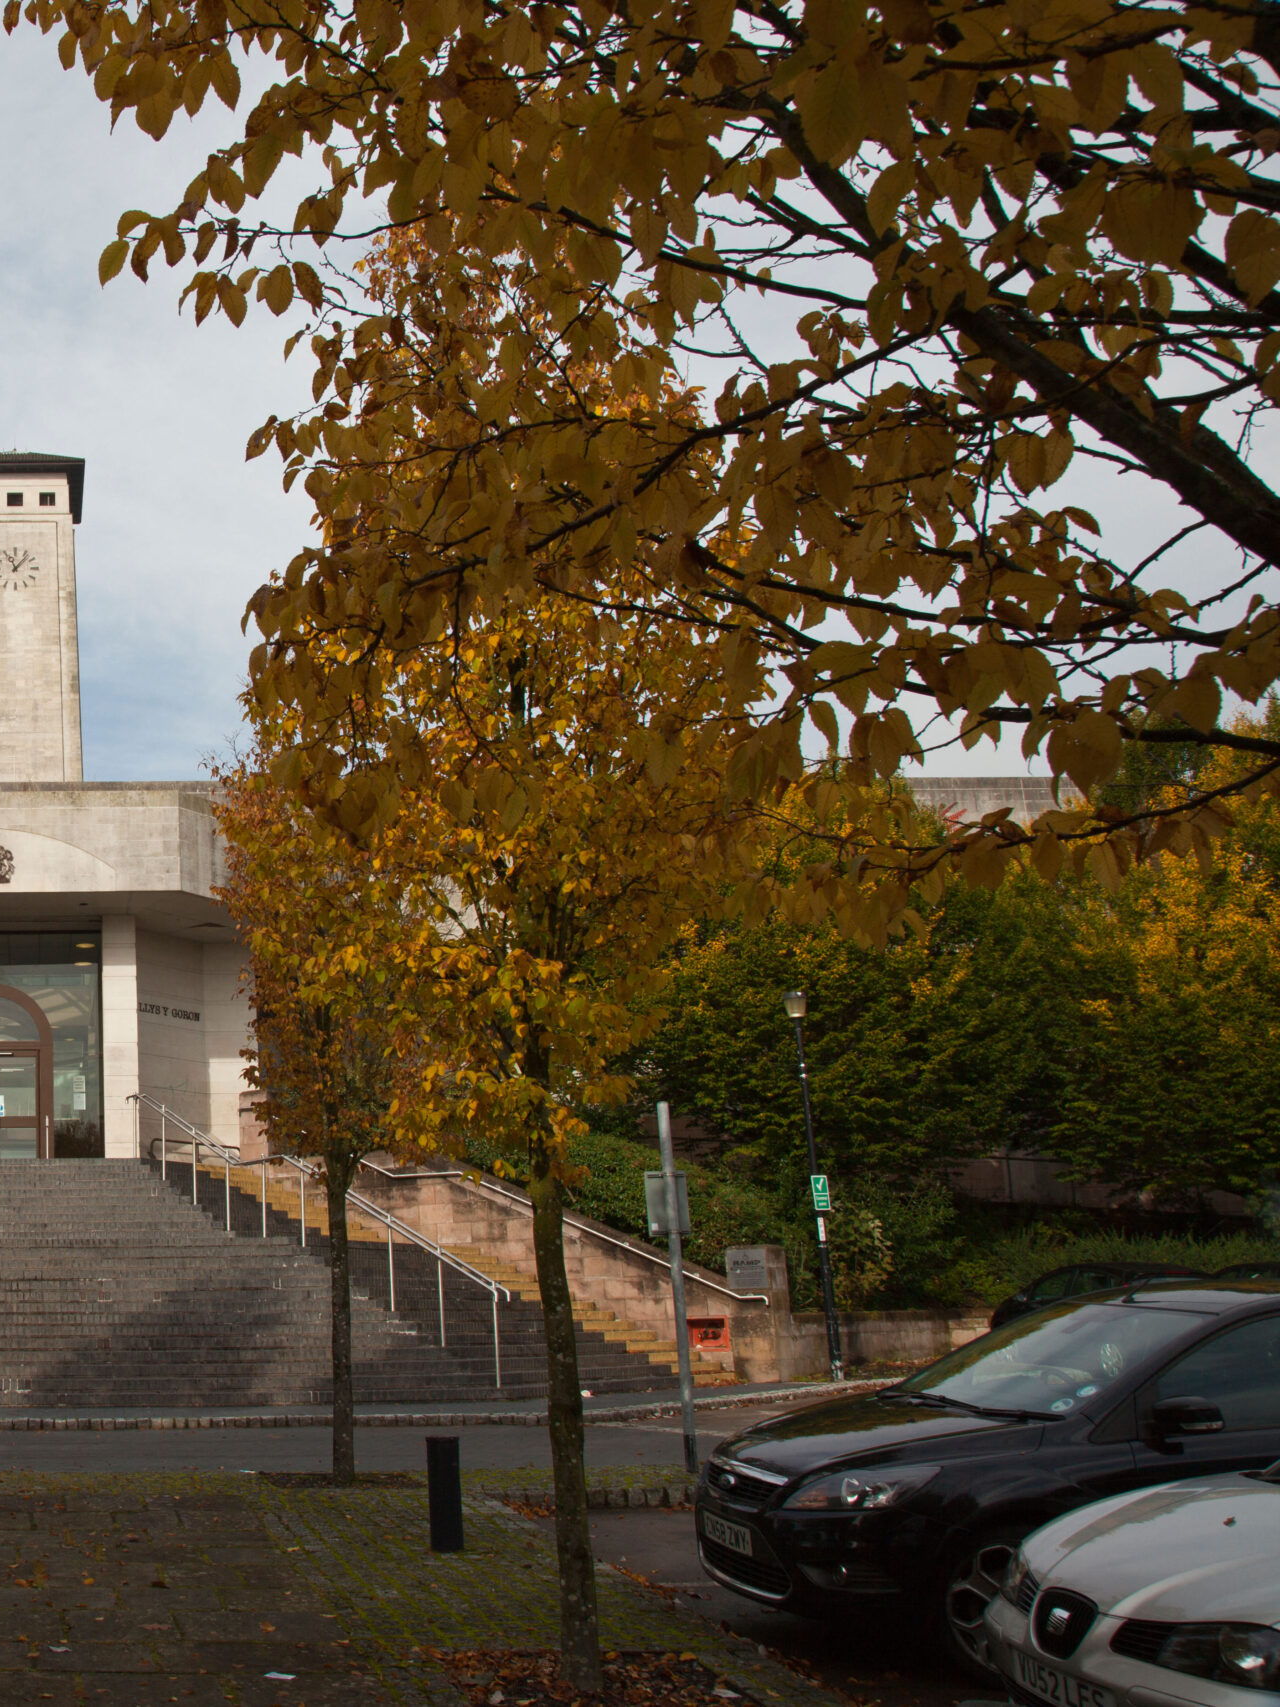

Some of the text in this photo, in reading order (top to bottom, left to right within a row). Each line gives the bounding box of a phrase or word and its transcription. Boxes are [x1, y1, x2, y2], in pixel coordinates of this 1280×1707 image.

[137, 1002, 200, 1022] LLYS Y GORON
[1017, 1652, 1061, 1702] VU52
